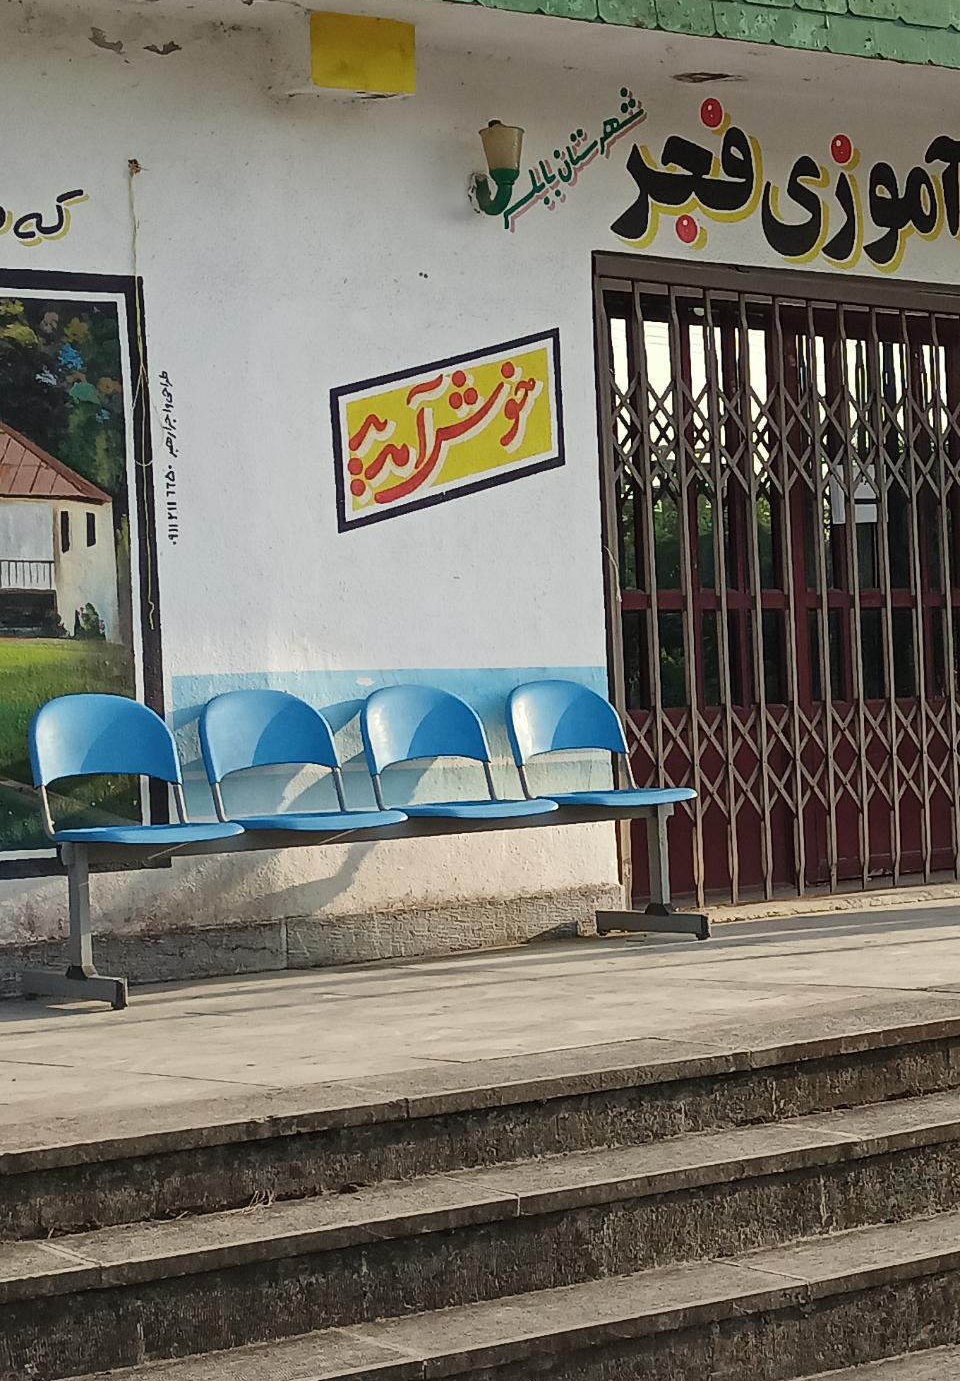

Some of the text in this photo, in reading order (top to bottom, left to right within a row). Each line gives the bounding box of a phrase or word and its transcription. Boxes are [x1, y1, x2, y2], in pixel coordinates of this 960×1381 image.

[503, 87, 645, 230] شهرستان بابلسر
[610, 97, 756, 244] فجر
[348, 361, 536, 505] خوش آمدید
